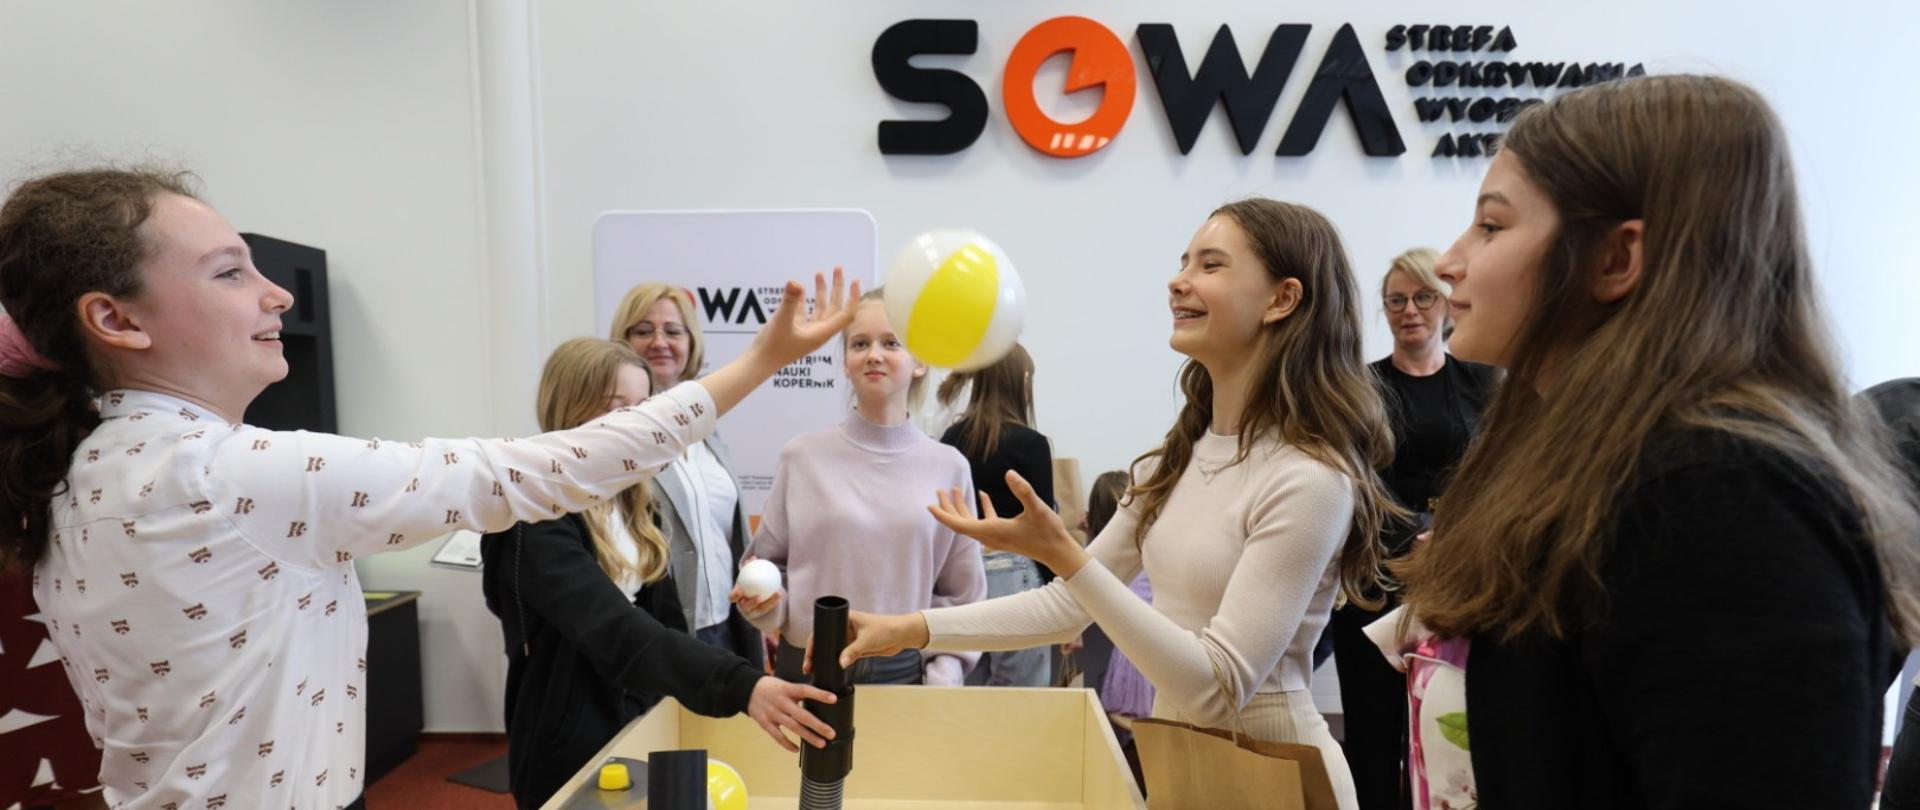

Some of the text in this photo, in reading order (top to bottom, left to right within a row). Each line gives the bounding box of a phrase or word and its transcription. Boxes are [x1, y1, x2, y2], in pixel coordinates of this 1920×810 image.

[1385, 24, 1517, 52] STREFA
[872, 15, 1406, 158] SOWA
[1414, 96, 1544, 123] WYOB
[684, 287, 767, 325] WA
